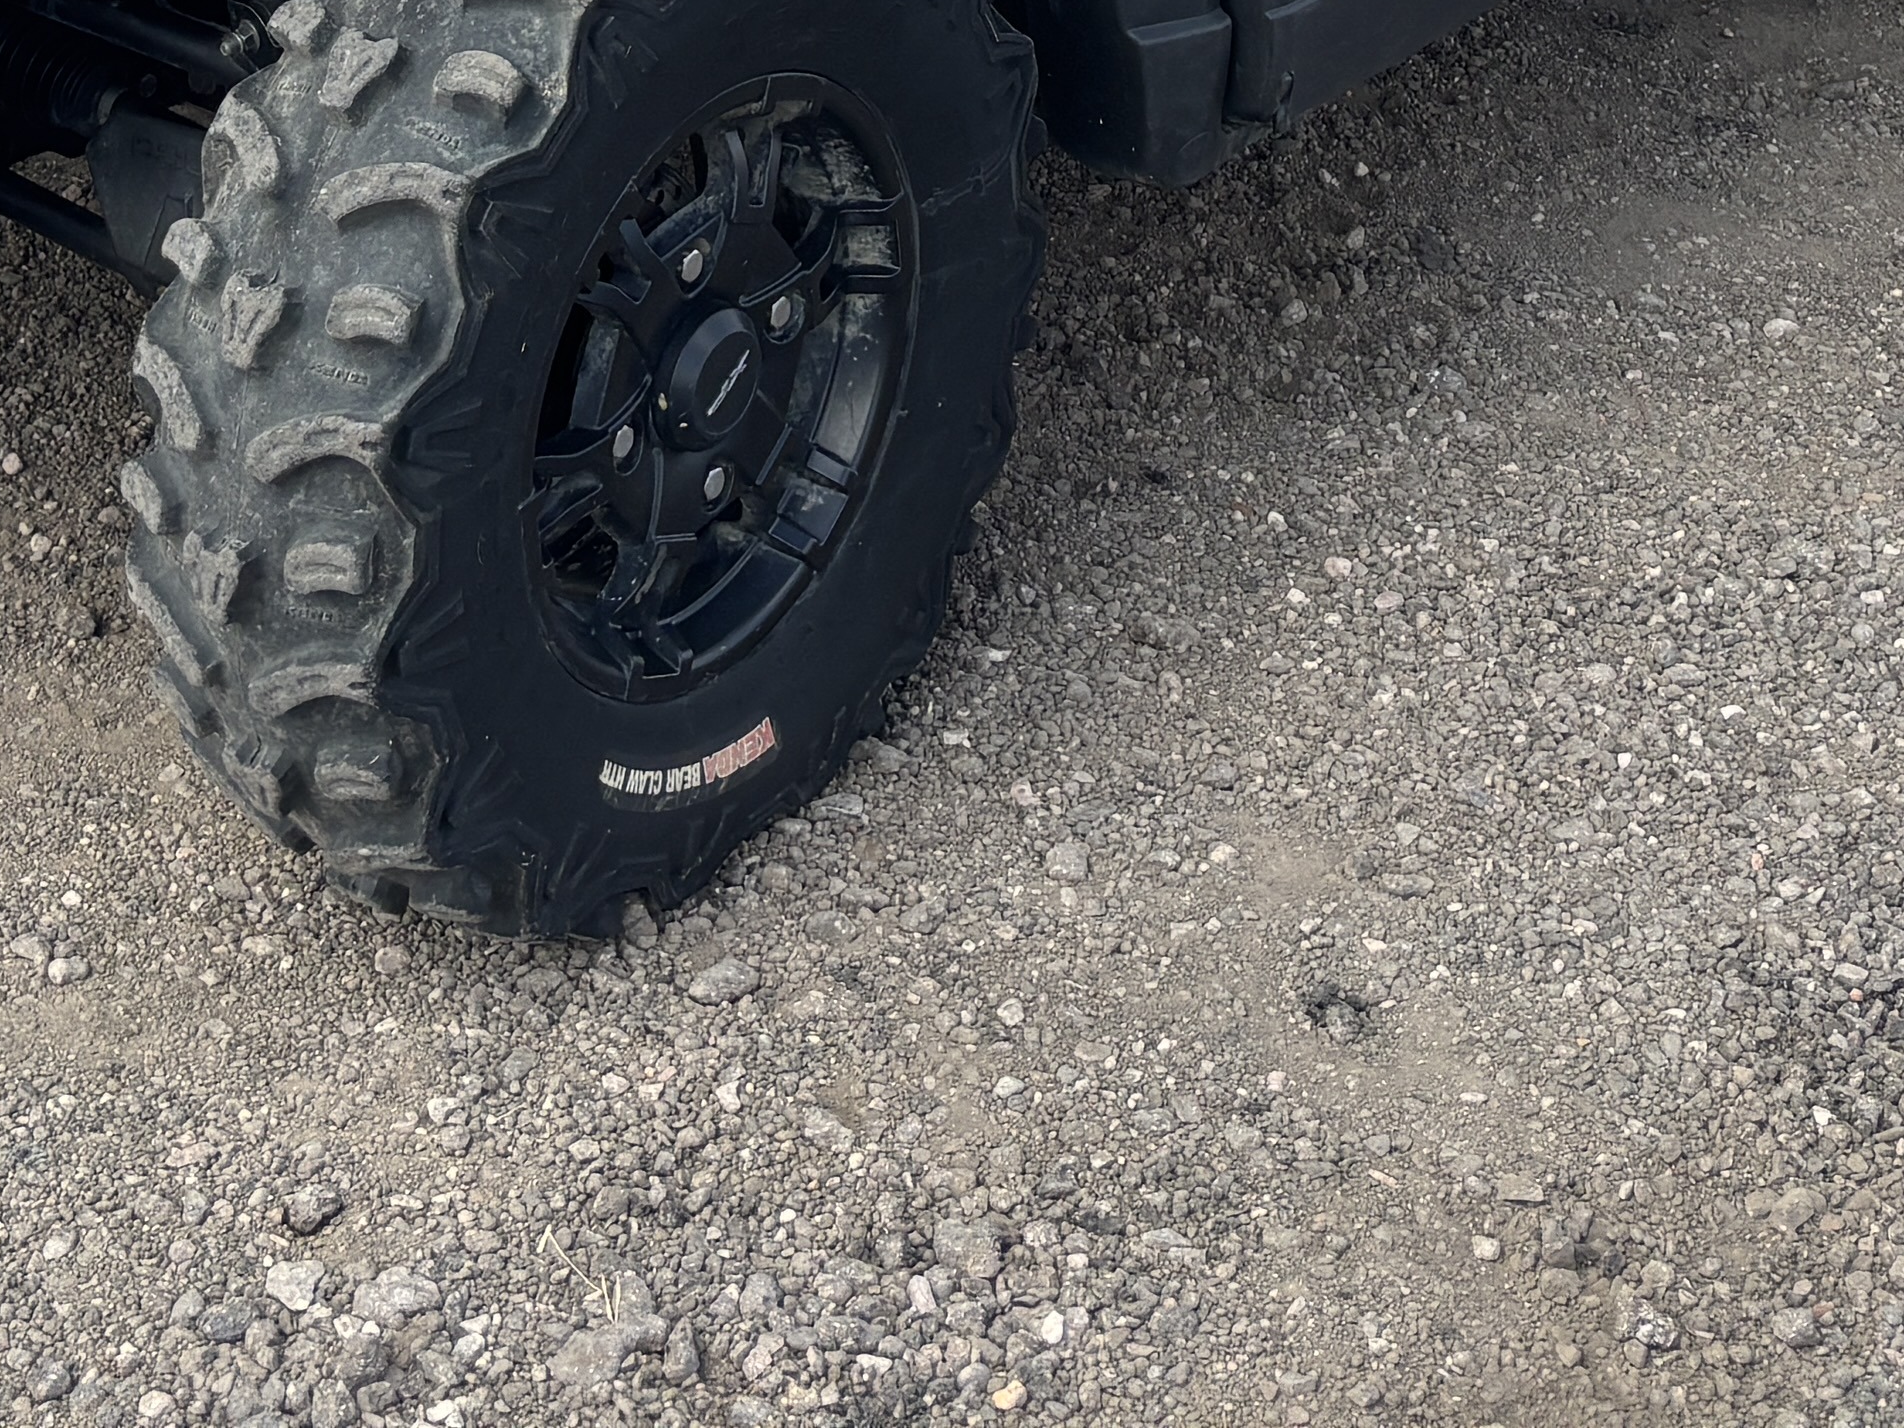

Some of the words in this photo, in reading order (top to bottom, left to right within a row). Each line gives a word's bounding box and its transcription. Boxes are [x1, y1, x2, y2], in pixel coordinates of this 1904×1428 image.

[702, 716, 776, 784] KENDA
[599, 759, 627, 791] HTR
[625, 769, 663, 795] CLAW
[665, 761, 701, 793] BEAR
